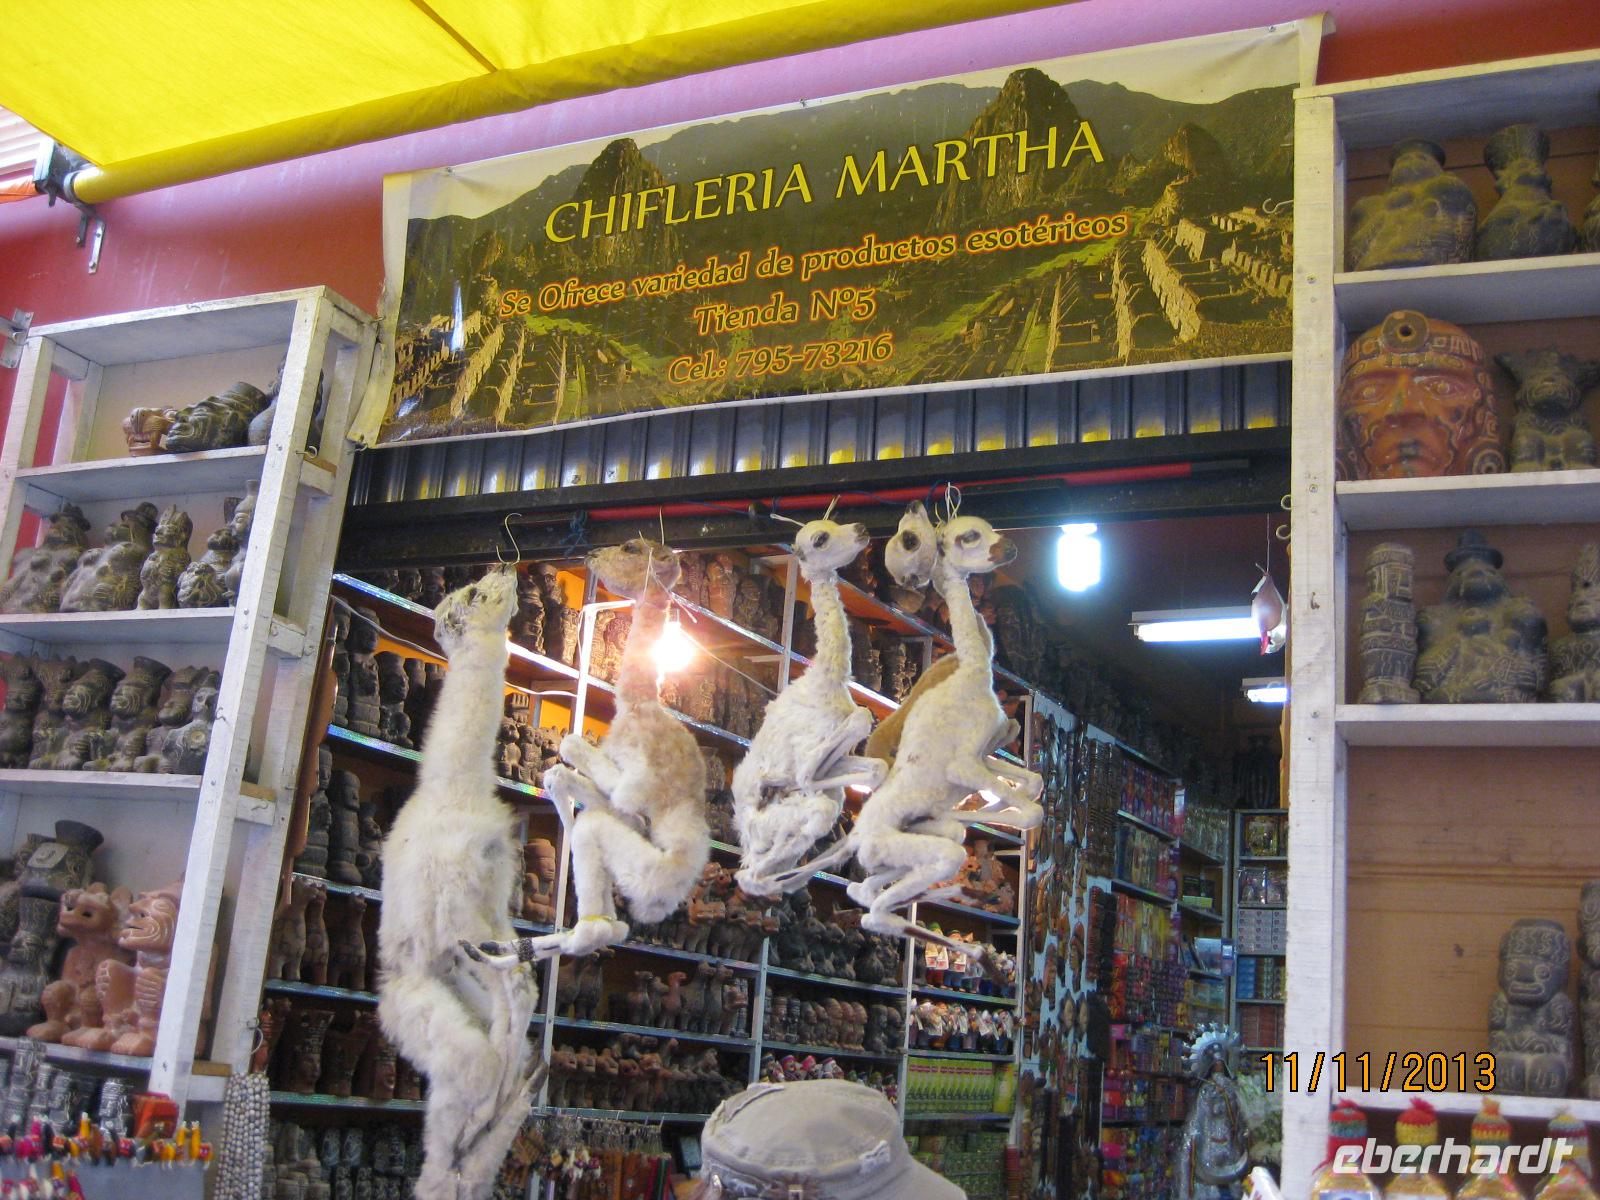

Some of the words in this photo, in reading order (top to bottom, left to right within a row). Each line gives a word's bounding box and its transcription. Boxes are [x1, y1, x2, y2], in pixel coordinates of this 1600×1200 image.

[545, 163, 812, 243] CHIFLERIA
[836, 121, 1104, 198] MARTHA
[501, 290, 530, 316] Se
[540, 277, 624, 310] Ofrece
[634, 252, 748, 295] variedad
[757, 247, 792, 276] de
[802, 236, 955, 280] productos
[967, 214, 1127, 252] esotéricos
[695, 292, 798, 335] Tienda
[811, 287, 876, 320] Nº5
[669, 351, 727, 383] Cel.:
[735, 333, 893, 377] 795-73216
